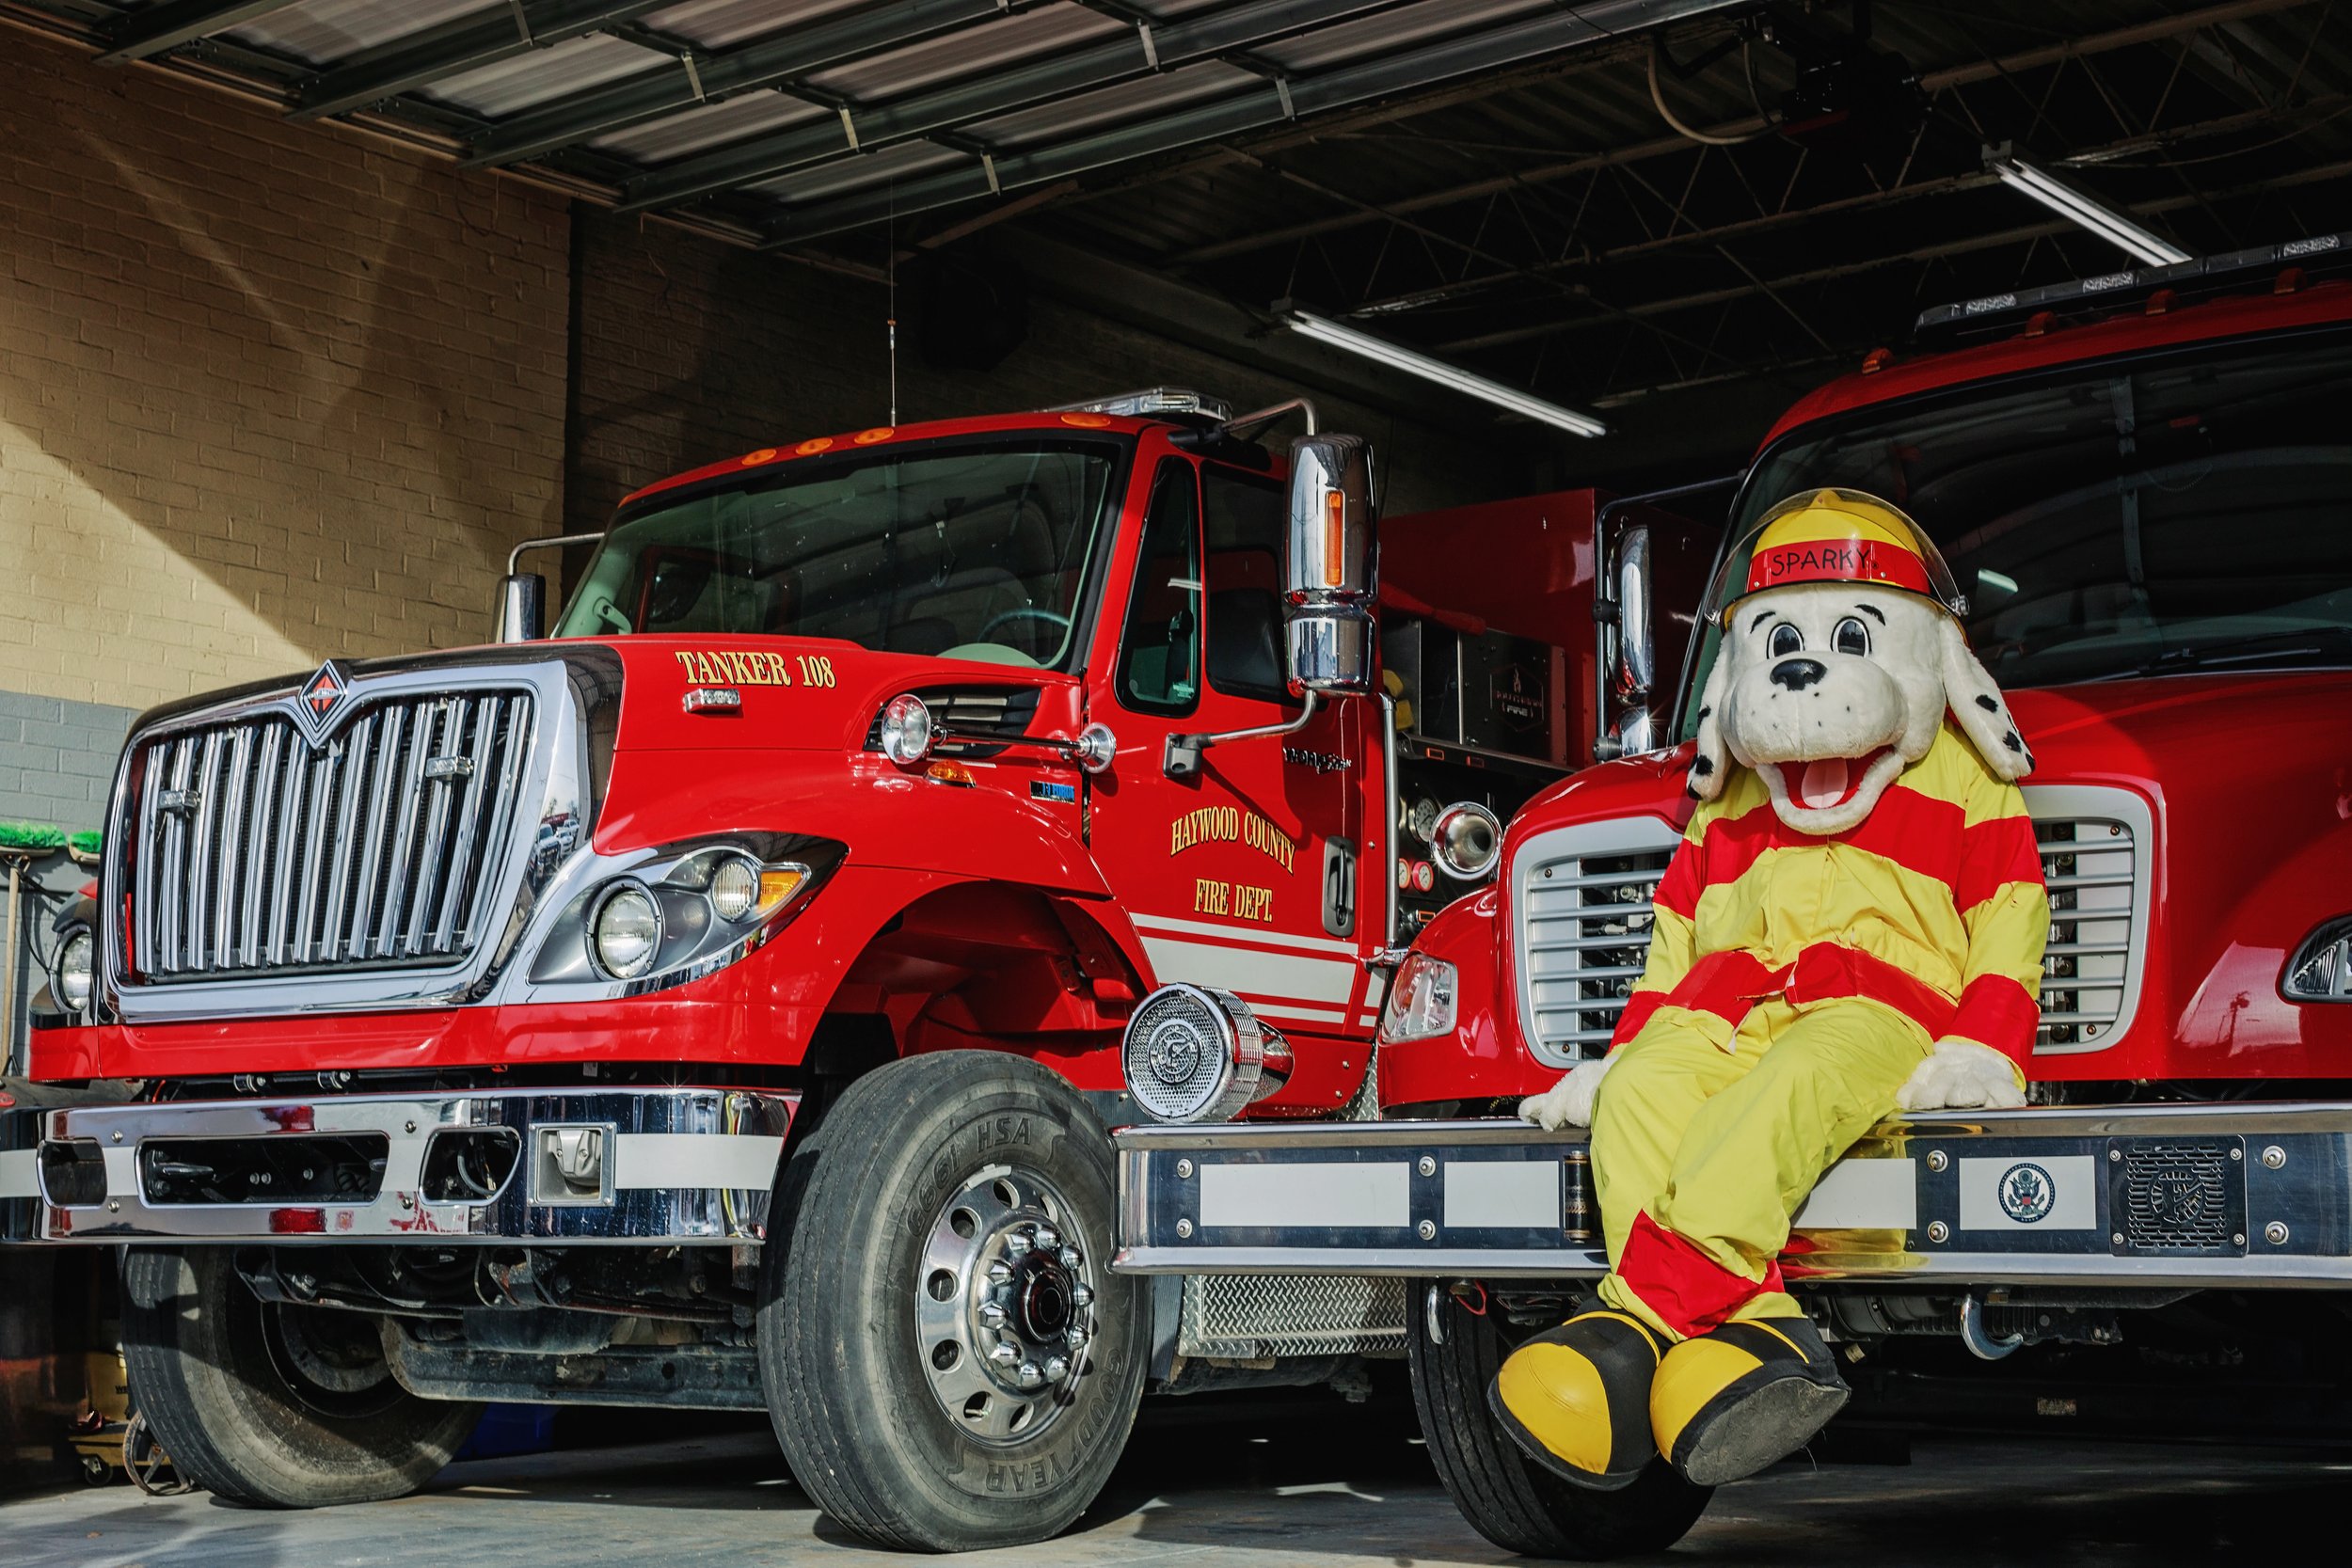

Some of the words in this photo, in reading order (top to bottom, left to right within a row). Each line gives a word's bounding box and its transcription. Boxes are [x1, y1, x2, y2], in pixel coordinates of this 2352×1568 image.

[675, 651, 791, 687] TANKER
[796, 655, 836, 689] 108
[1170, 805, 1239, 857] HAYWOOD
[1244, 811, 1295, 876] COUNTY
[1194, 878, 1230, 915] FIRE
[1233, 884, 1273, 923] DEPT.
[977, 1117, 1032, 1153] HSA
